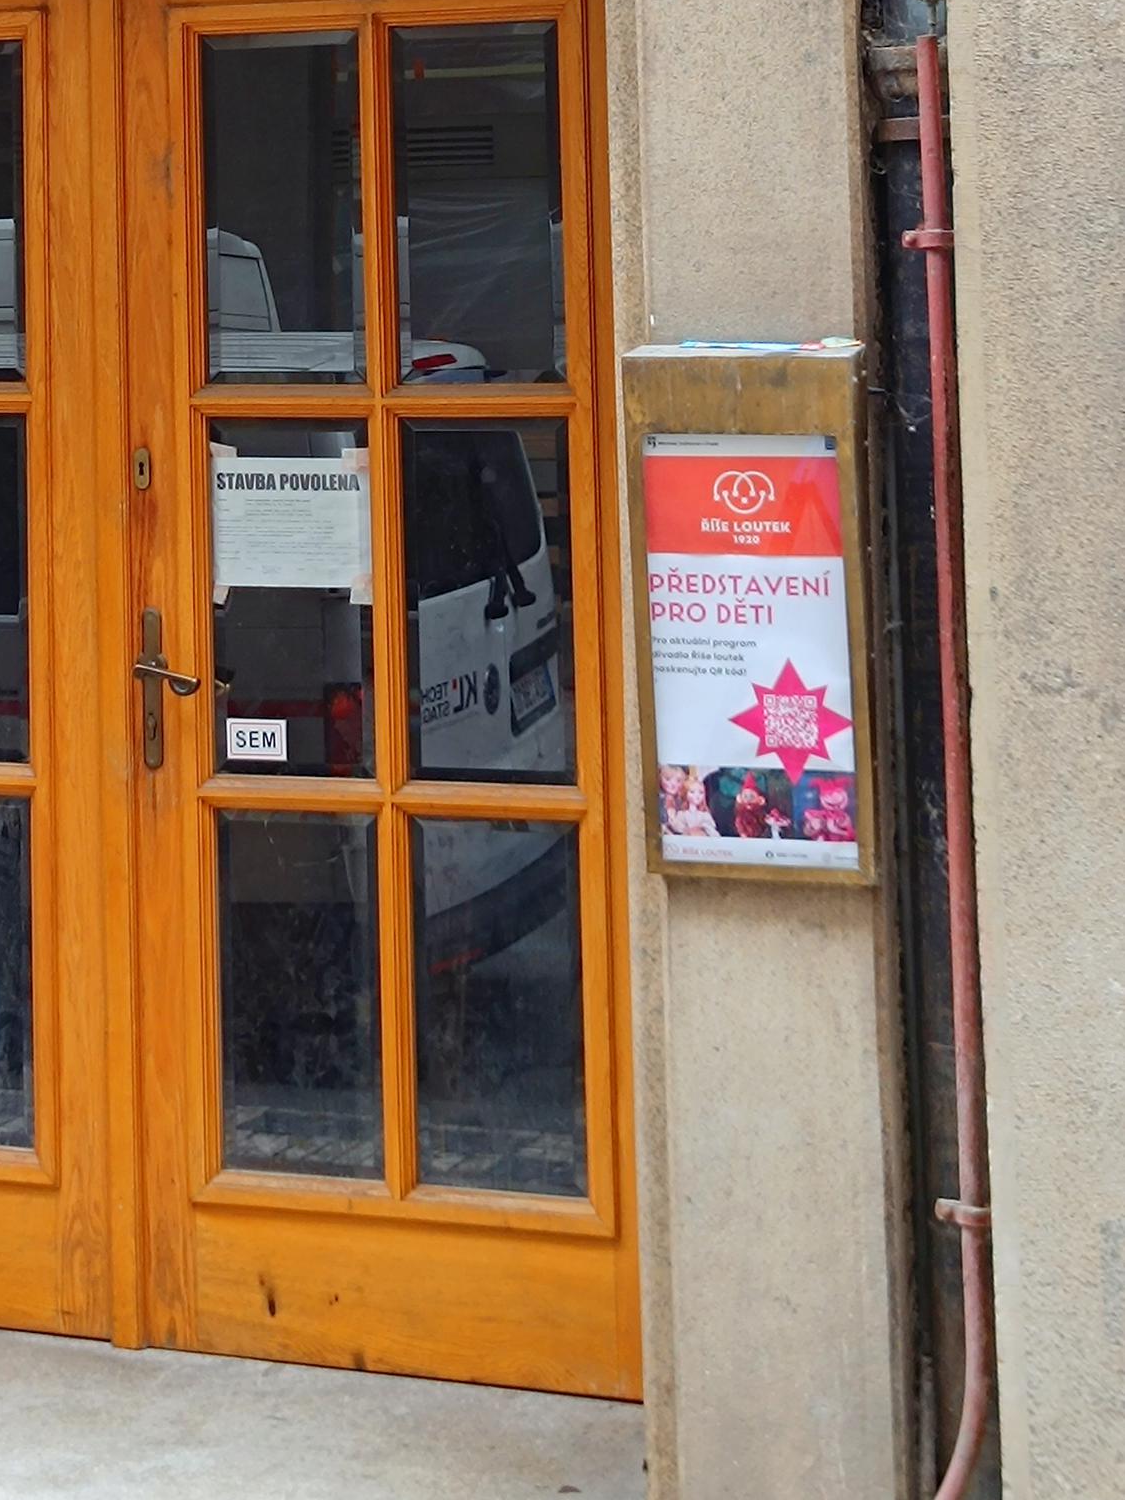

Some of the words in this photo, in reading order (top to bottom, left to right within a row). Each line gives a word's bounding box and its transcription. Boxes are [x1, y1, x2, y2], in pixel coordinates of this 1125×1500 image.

[217, 472, 276, 490] STAVBA
[280, 474, 360, 491] POVOLENA
[733, 520, 791, 533] LOUTEK
[733, 535, 760, 544] 1920
[649, 567, 831, 597] PŘEDSTAVENÍ
[651, 601, 707, 622] PRO
[717, 597, 773, 624] DĚTI
[713, 639, 757, 649] program
[713, 652, 744, 661] loutek
[235, 730, 277, 748] SEM
